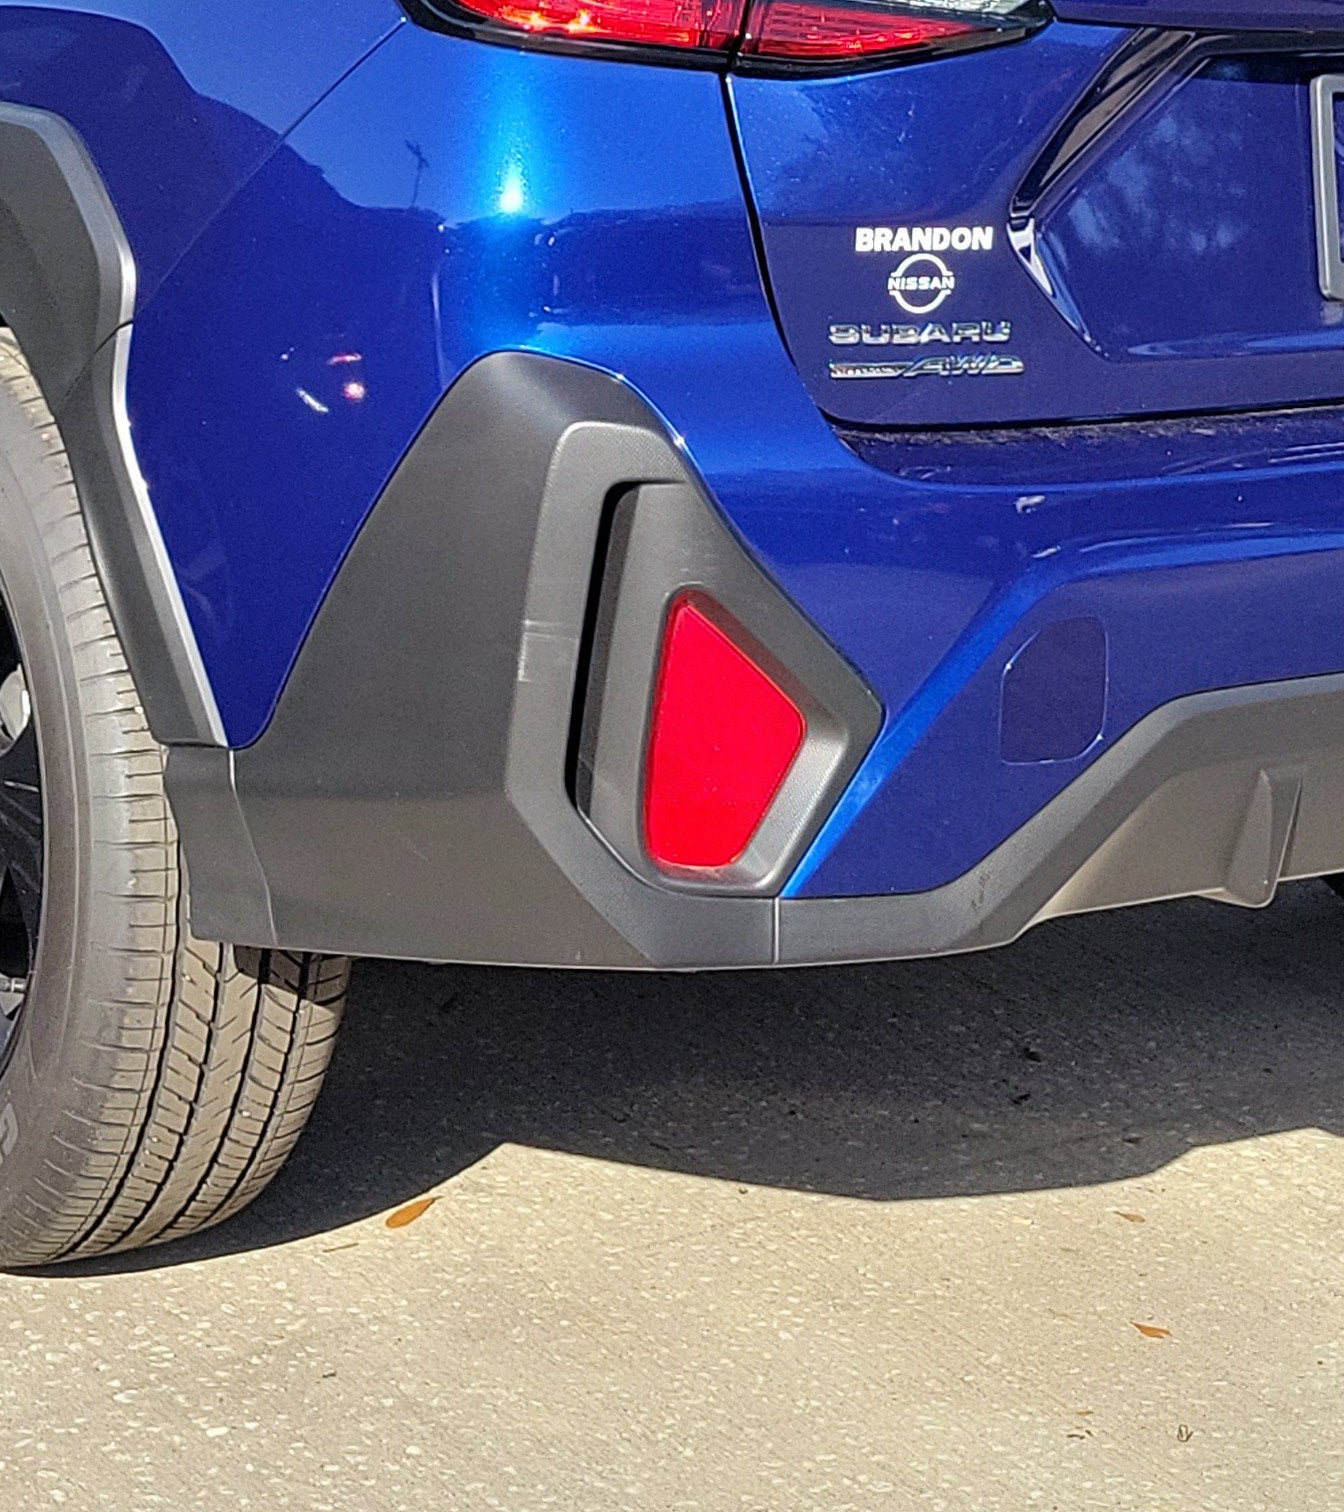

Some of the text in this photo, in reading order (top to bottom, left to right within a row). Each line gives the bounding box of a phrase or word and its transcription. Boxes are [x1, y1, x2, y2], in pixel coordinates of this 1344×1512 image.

[855, 227, 994, 252] BRANDON
[888, 276, 955, 290] NISSAN
[829, 321, 1011, 345] SUBARU
[903, 355, 1024, 376] AWD
